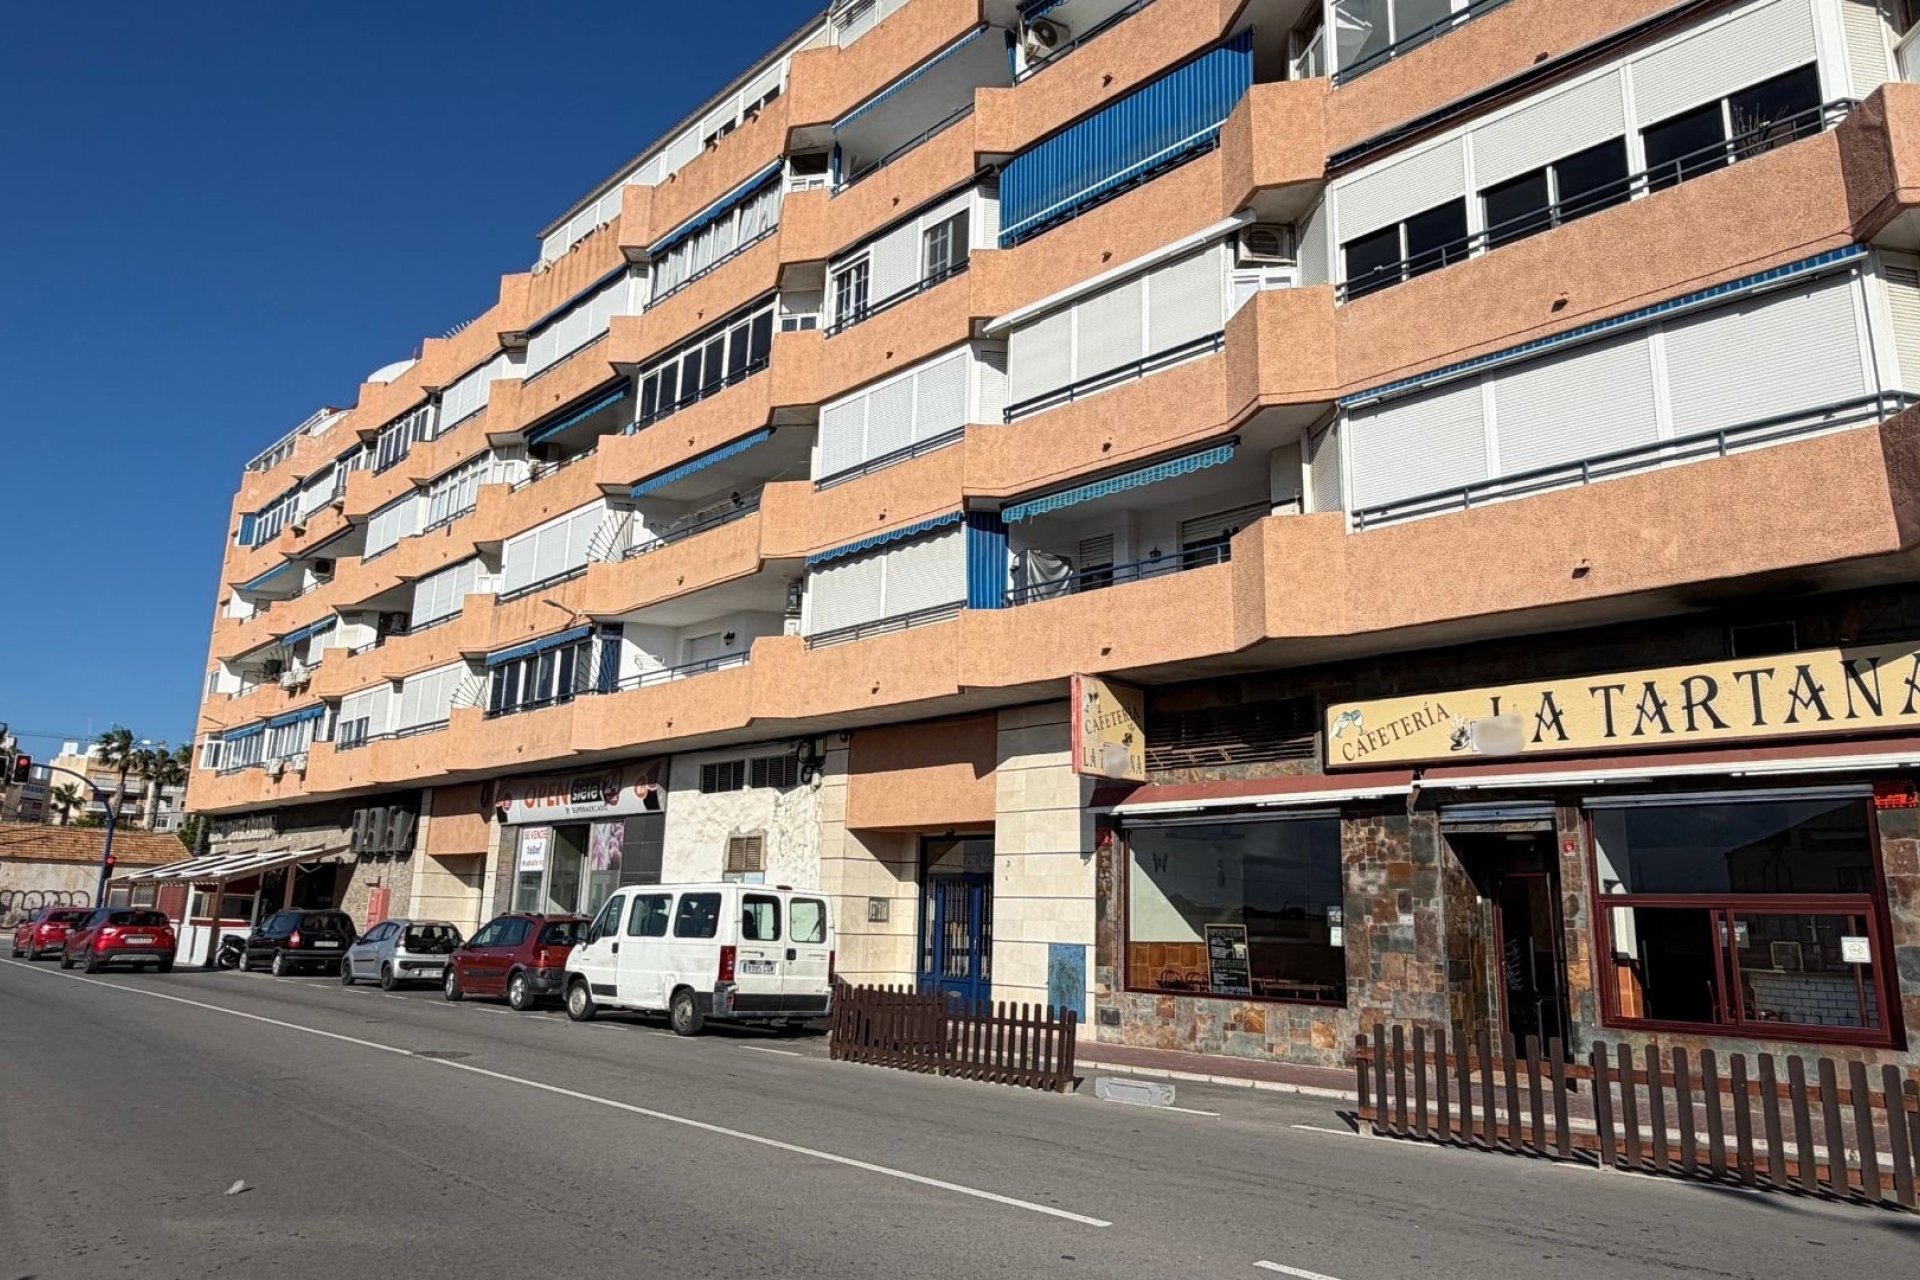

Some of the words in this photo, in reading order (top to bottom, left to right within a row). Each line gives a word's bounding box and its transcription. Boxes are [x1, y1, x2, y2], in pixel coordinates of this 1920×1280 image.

[1342, 701, 1450, 762] CAFETERÍA
[1083, 747, 1097, 768] LA
[524, 781, 569, 809] OPEN
